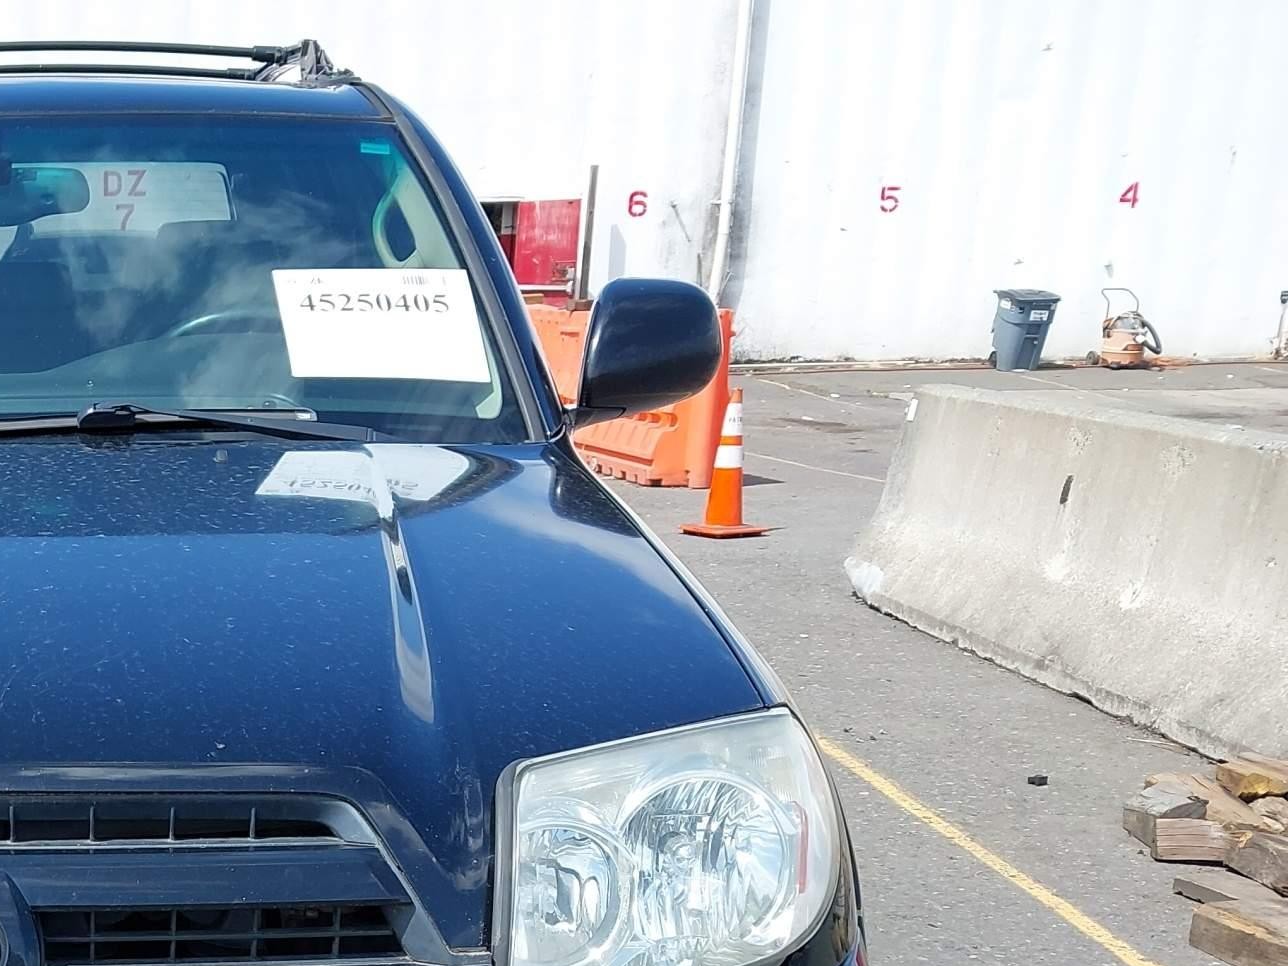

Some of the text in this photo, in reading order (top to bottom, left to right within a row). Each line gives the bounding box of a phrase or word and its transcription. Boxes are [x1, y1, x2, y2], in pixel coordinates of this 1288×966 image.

[103, 169, 147, 197] DZ
[1119, 181, 1139, 209] 4
[628, 190, 648, 217] 6
[880, 186, 901, 213] 5
[115, 203, 135, 232] 7
[299, 293, 449, 313] 45250405
